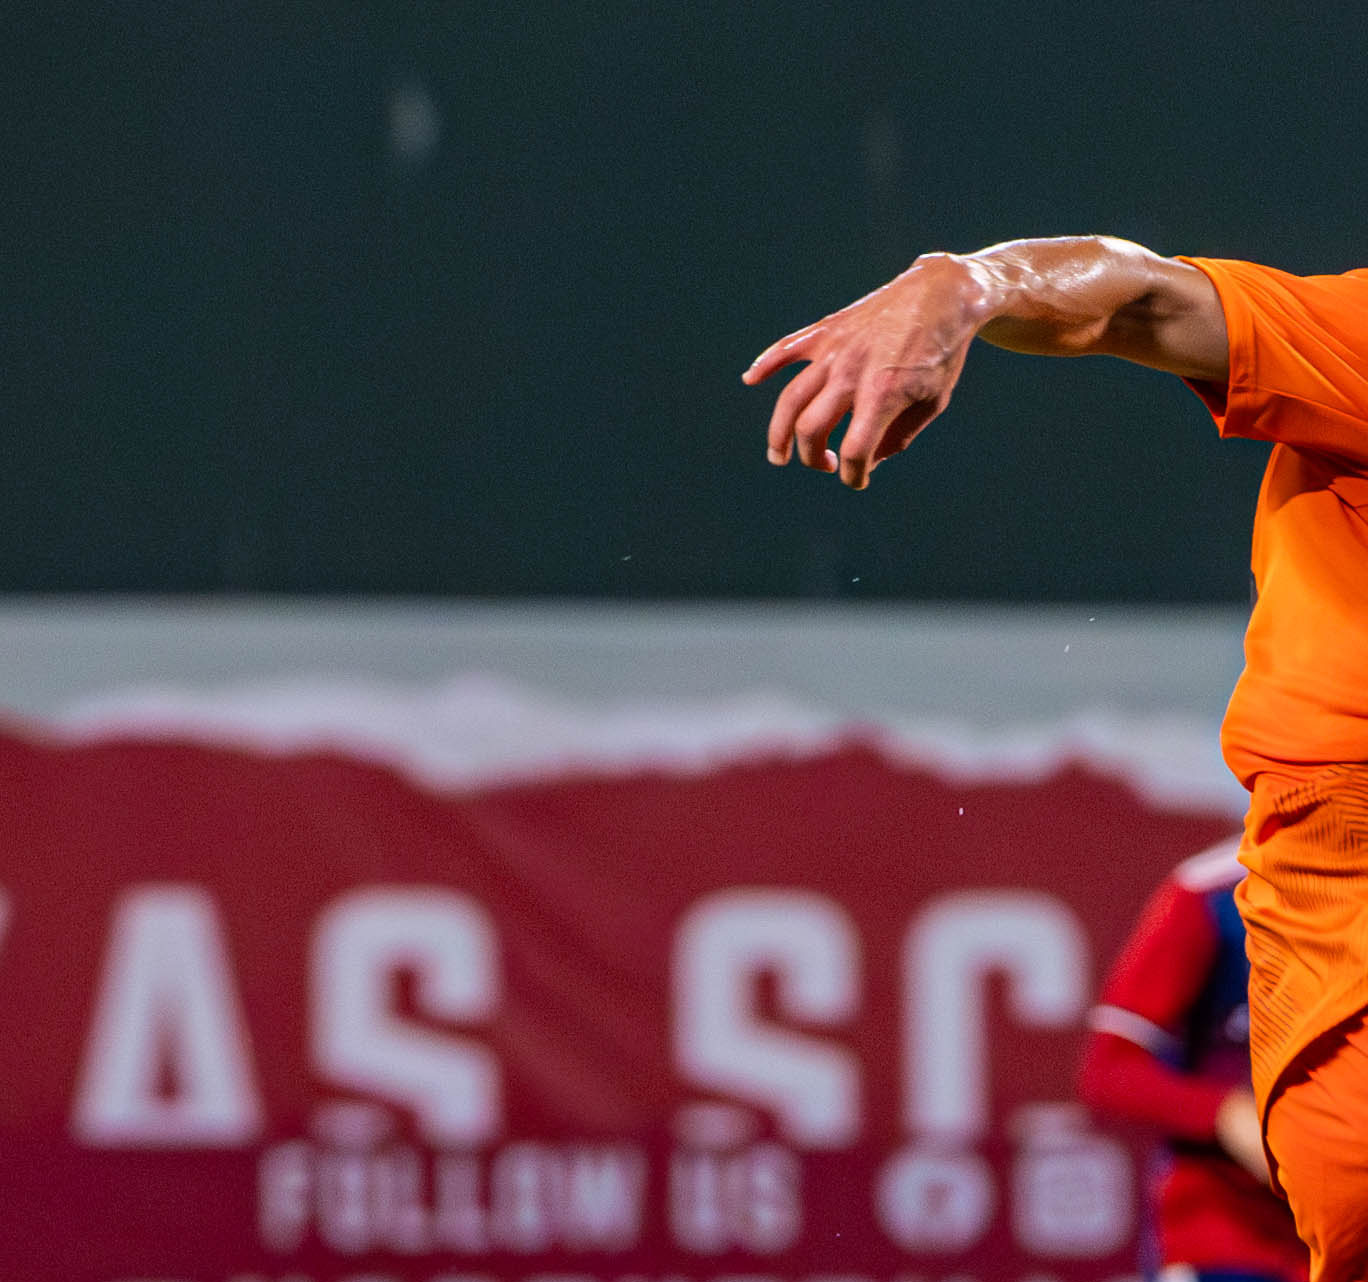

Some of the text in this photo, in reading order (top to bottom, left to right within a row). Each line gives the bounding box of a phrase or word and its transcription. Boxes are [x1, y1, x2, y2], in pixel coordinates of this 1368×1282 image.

[0, 886, 502, 1148] AS
[258, 1140, 803, 1256] FOLLOW US
